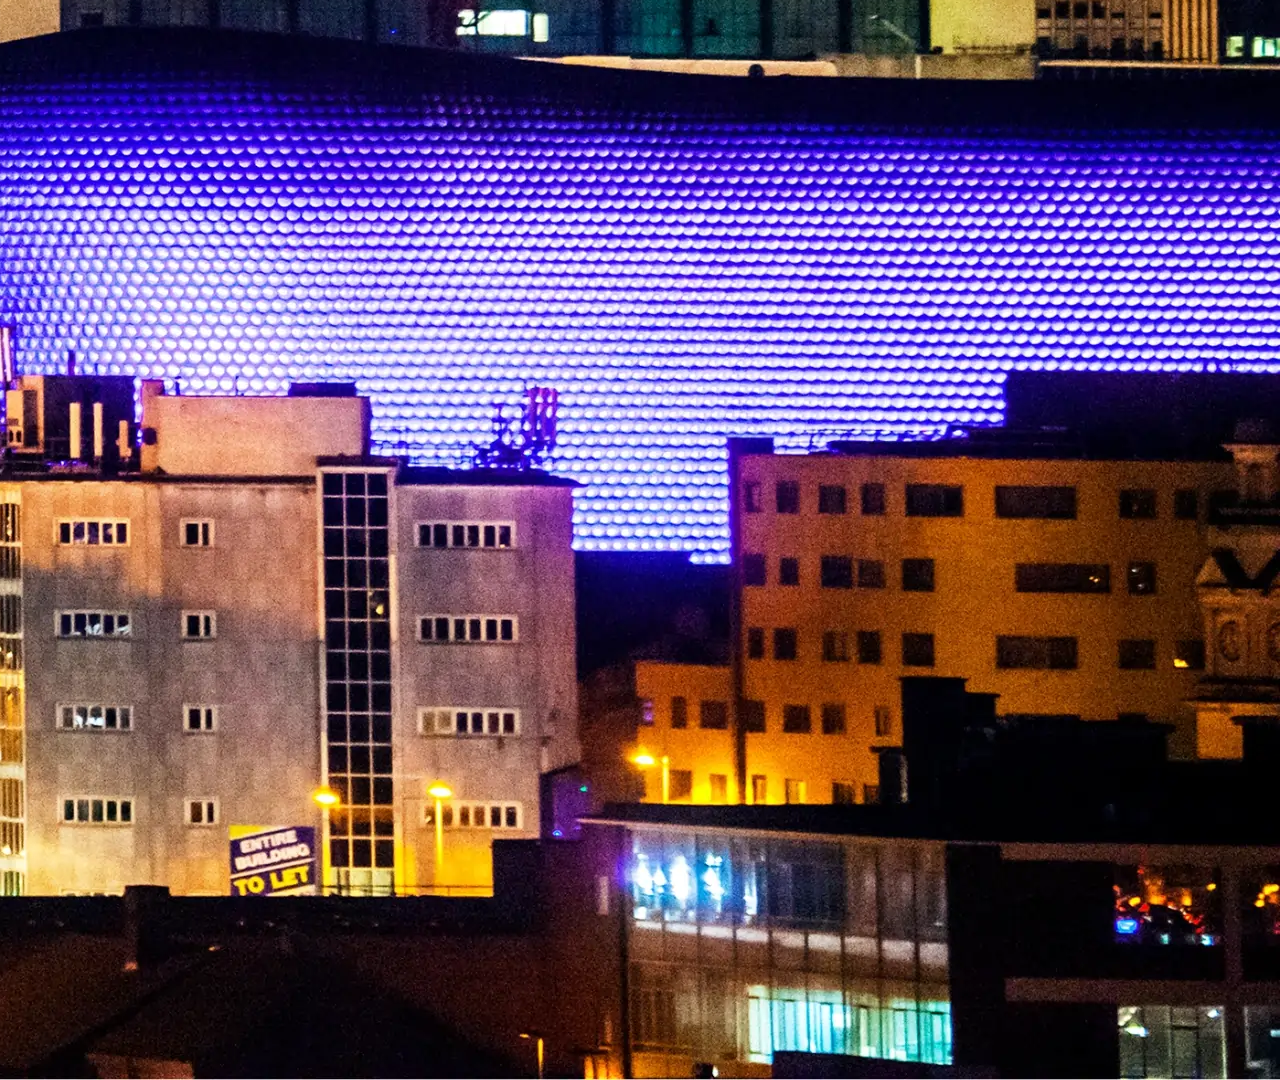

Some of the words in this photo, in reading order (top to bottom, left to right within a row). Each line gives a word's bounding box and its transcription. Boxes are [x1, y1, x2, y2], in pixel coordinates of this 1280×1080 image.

[240, 829, 298, 853] ENTIRE
[234, 843, 310, 870] BUILDING
[233, 875, 265, 896] TO
[269, 865, 309, 890] LET
